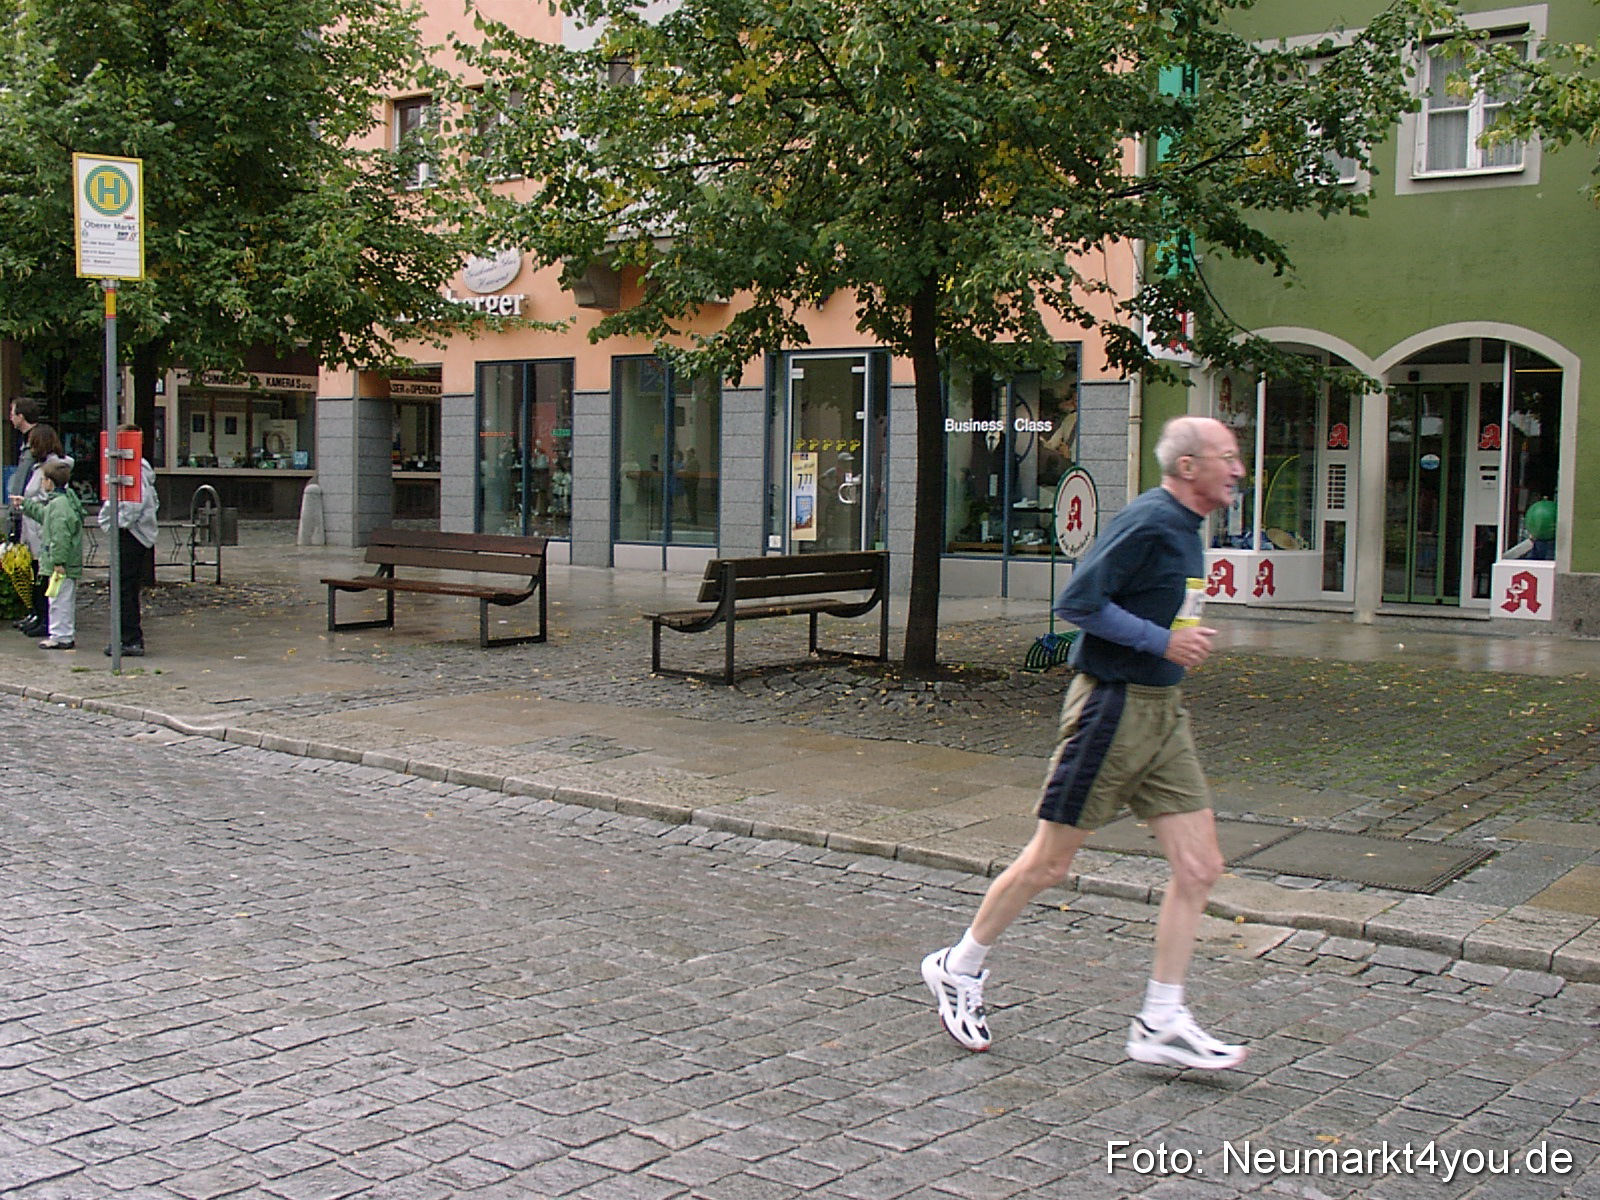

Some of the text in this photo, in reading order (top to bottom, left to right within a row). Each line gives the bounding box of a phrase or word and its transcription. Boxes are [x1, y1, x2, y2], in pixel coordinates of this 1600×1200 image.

[98, 177, 120, 205] H
[84, 220, 135, 231] Oberer Markt
[944, 418, 1053, 432] Business Class
